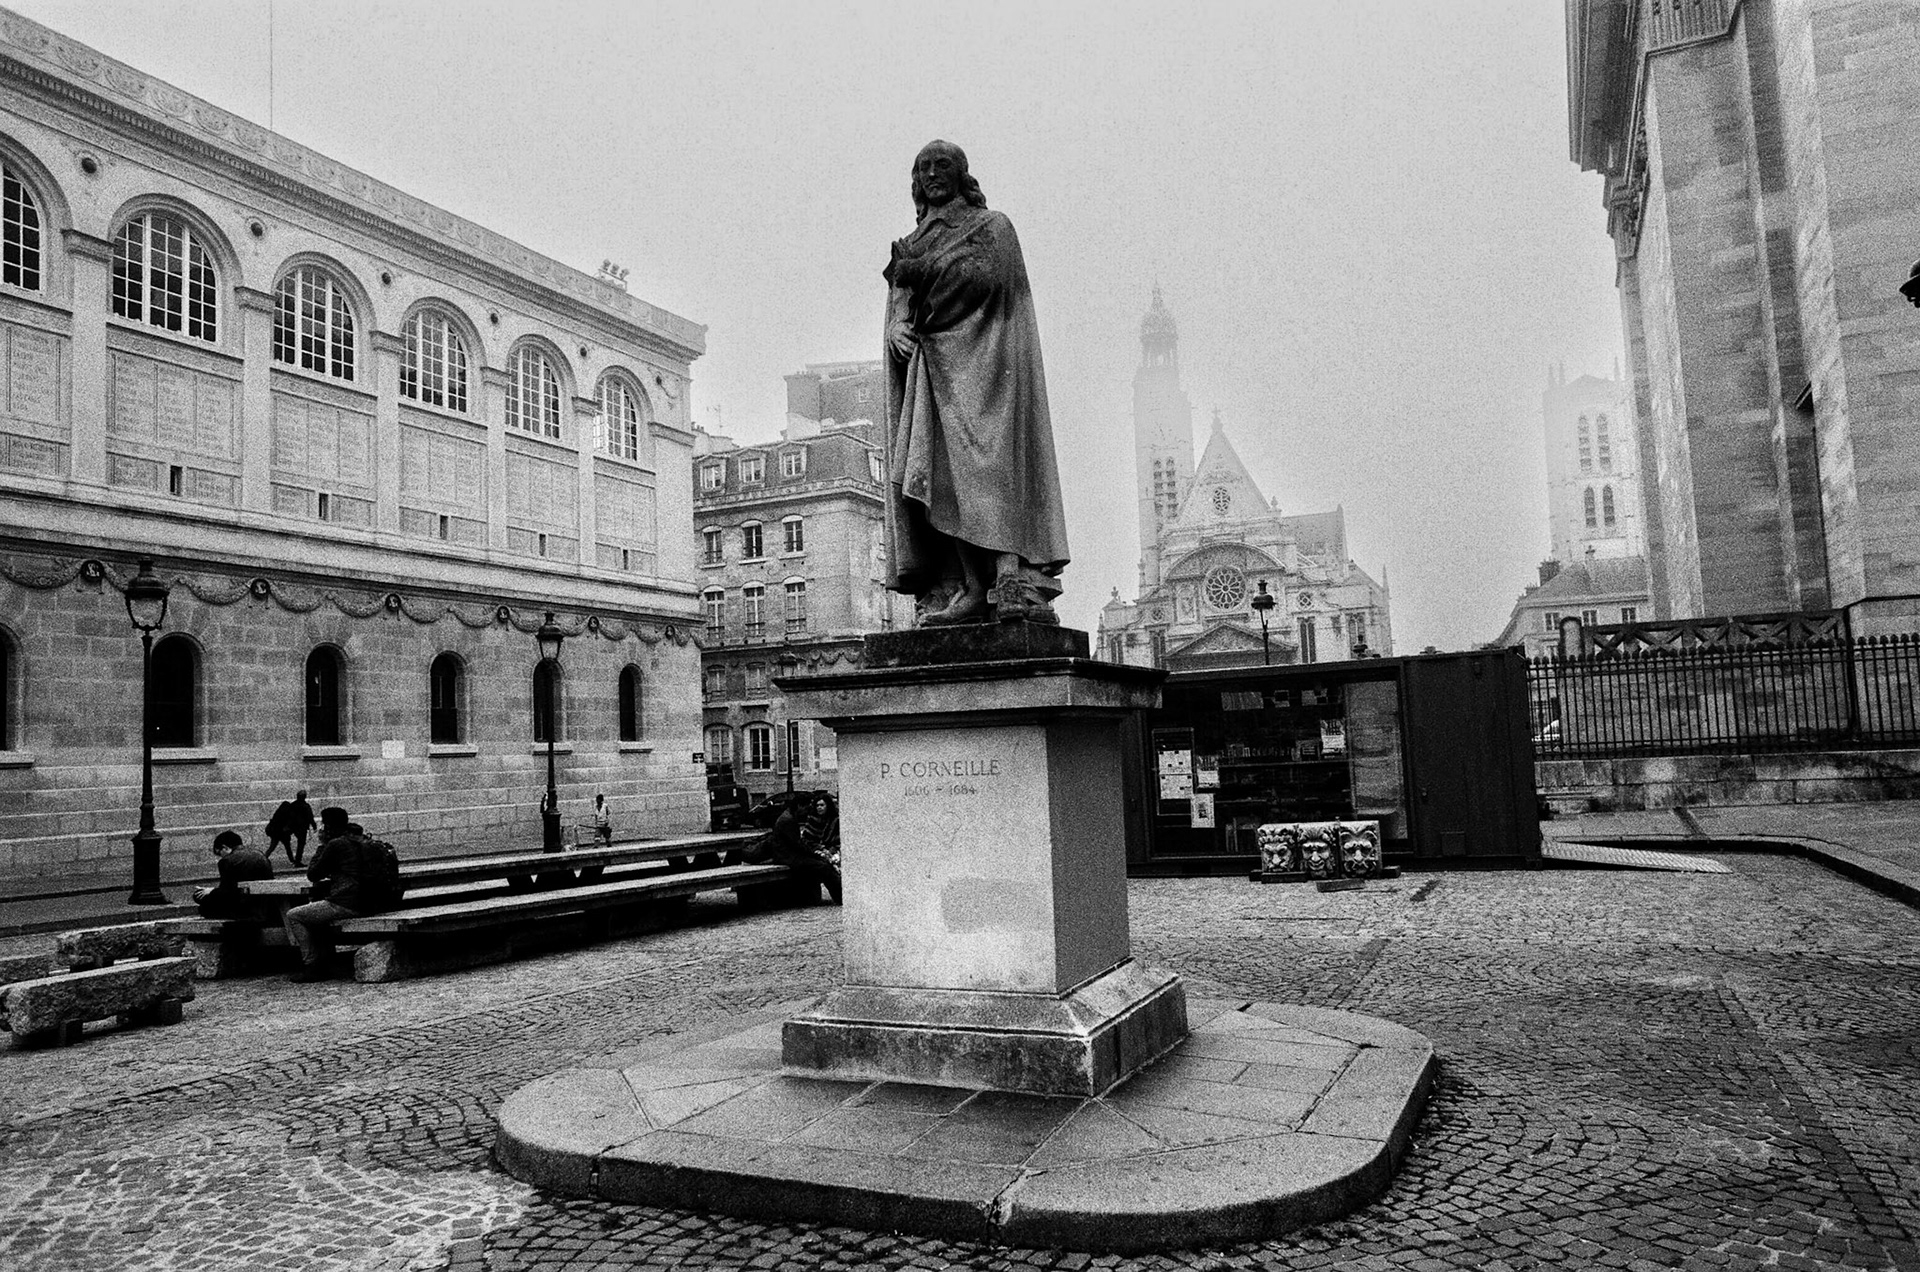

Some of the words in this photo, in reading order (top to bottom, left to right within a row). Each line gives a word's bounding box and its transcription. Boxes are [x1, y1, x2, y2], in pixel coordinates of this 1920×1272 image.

[880, 762, 894, 780] P.
[899, 759, 1001, 778] CORNEILLE
[904, 784, 930, 797] 1606
[949, 784, 978, 796] 1684
